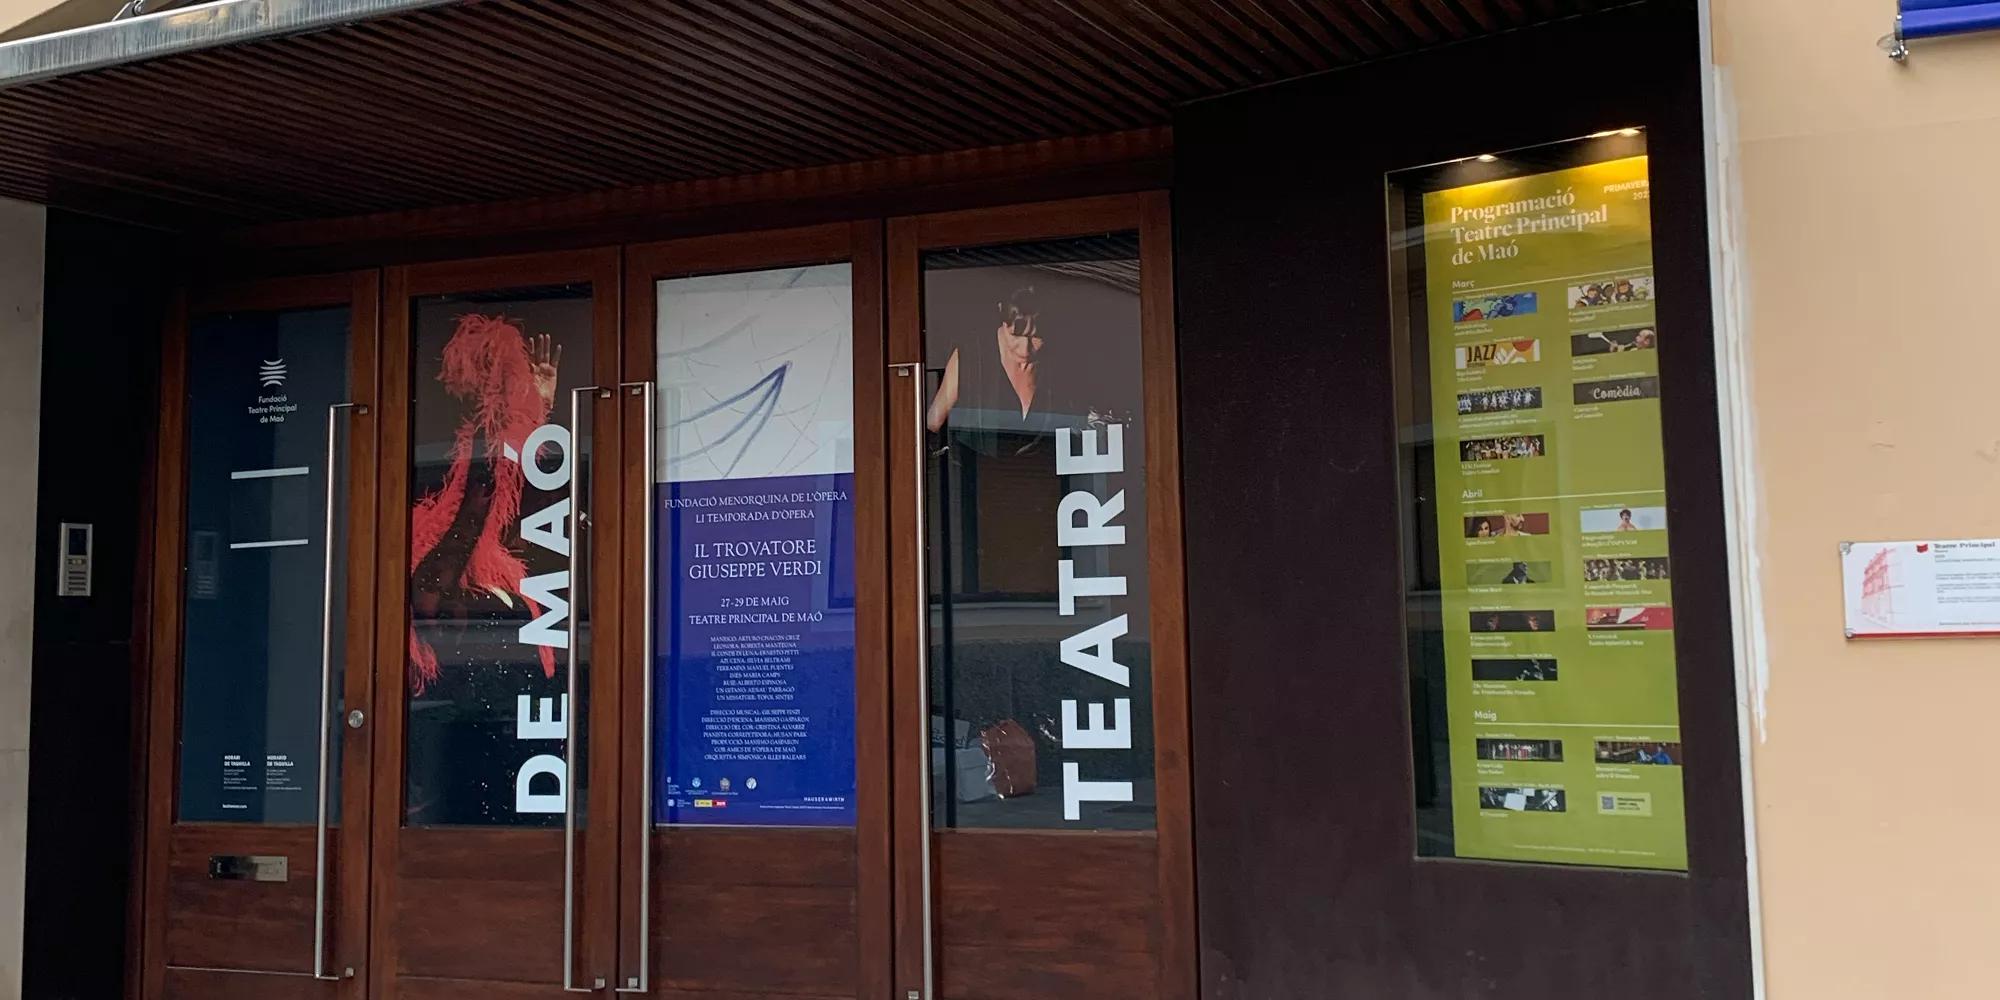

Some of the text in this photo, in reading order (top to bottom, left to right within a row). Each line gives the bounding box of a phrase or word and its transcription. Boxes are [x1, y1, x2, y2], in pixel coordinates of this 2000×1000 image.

[1451, 187, 1575, 224] Programació
[1451, 205, 1608, 244] Teatre Principal
[1452, 240, 1519, 265] de Maó
[1452, 280, 1475, 289] Març
[1467, 344, 1497, 362] JAZZ
[258, 394, 287, 403] Fundació
[1593, 385, 1641, 400] Comèdia
[248, 404, 297, 414] Teatre Principal
[270, 414, 284, 422] Maó
[664, 490, 847, 508] FUNDACIÓ MENORQUINA DE L'ÒPERA
[1462, 489, 1483, 498] Abril
[707, 512, 770, 523] TEMPORADA
[772, 509, 815, 520] D'ÒPERA
[502, 424, 571, 649] MAÓ
[694, 540, 816, 558] IL TROVATORE
[689, 560, 822, 580] GIUSEPPE VERDI
[720, 596, 789, 607] 27-29 DE MAIG
[689, 611, 822, 625] TEATRE PRINCIPAL DE MAÓ
[1056, 424, 1133, 820] TEATRE
[1474, 710, 1497, 721] Maig
[516, 693, 568, 813] DE
